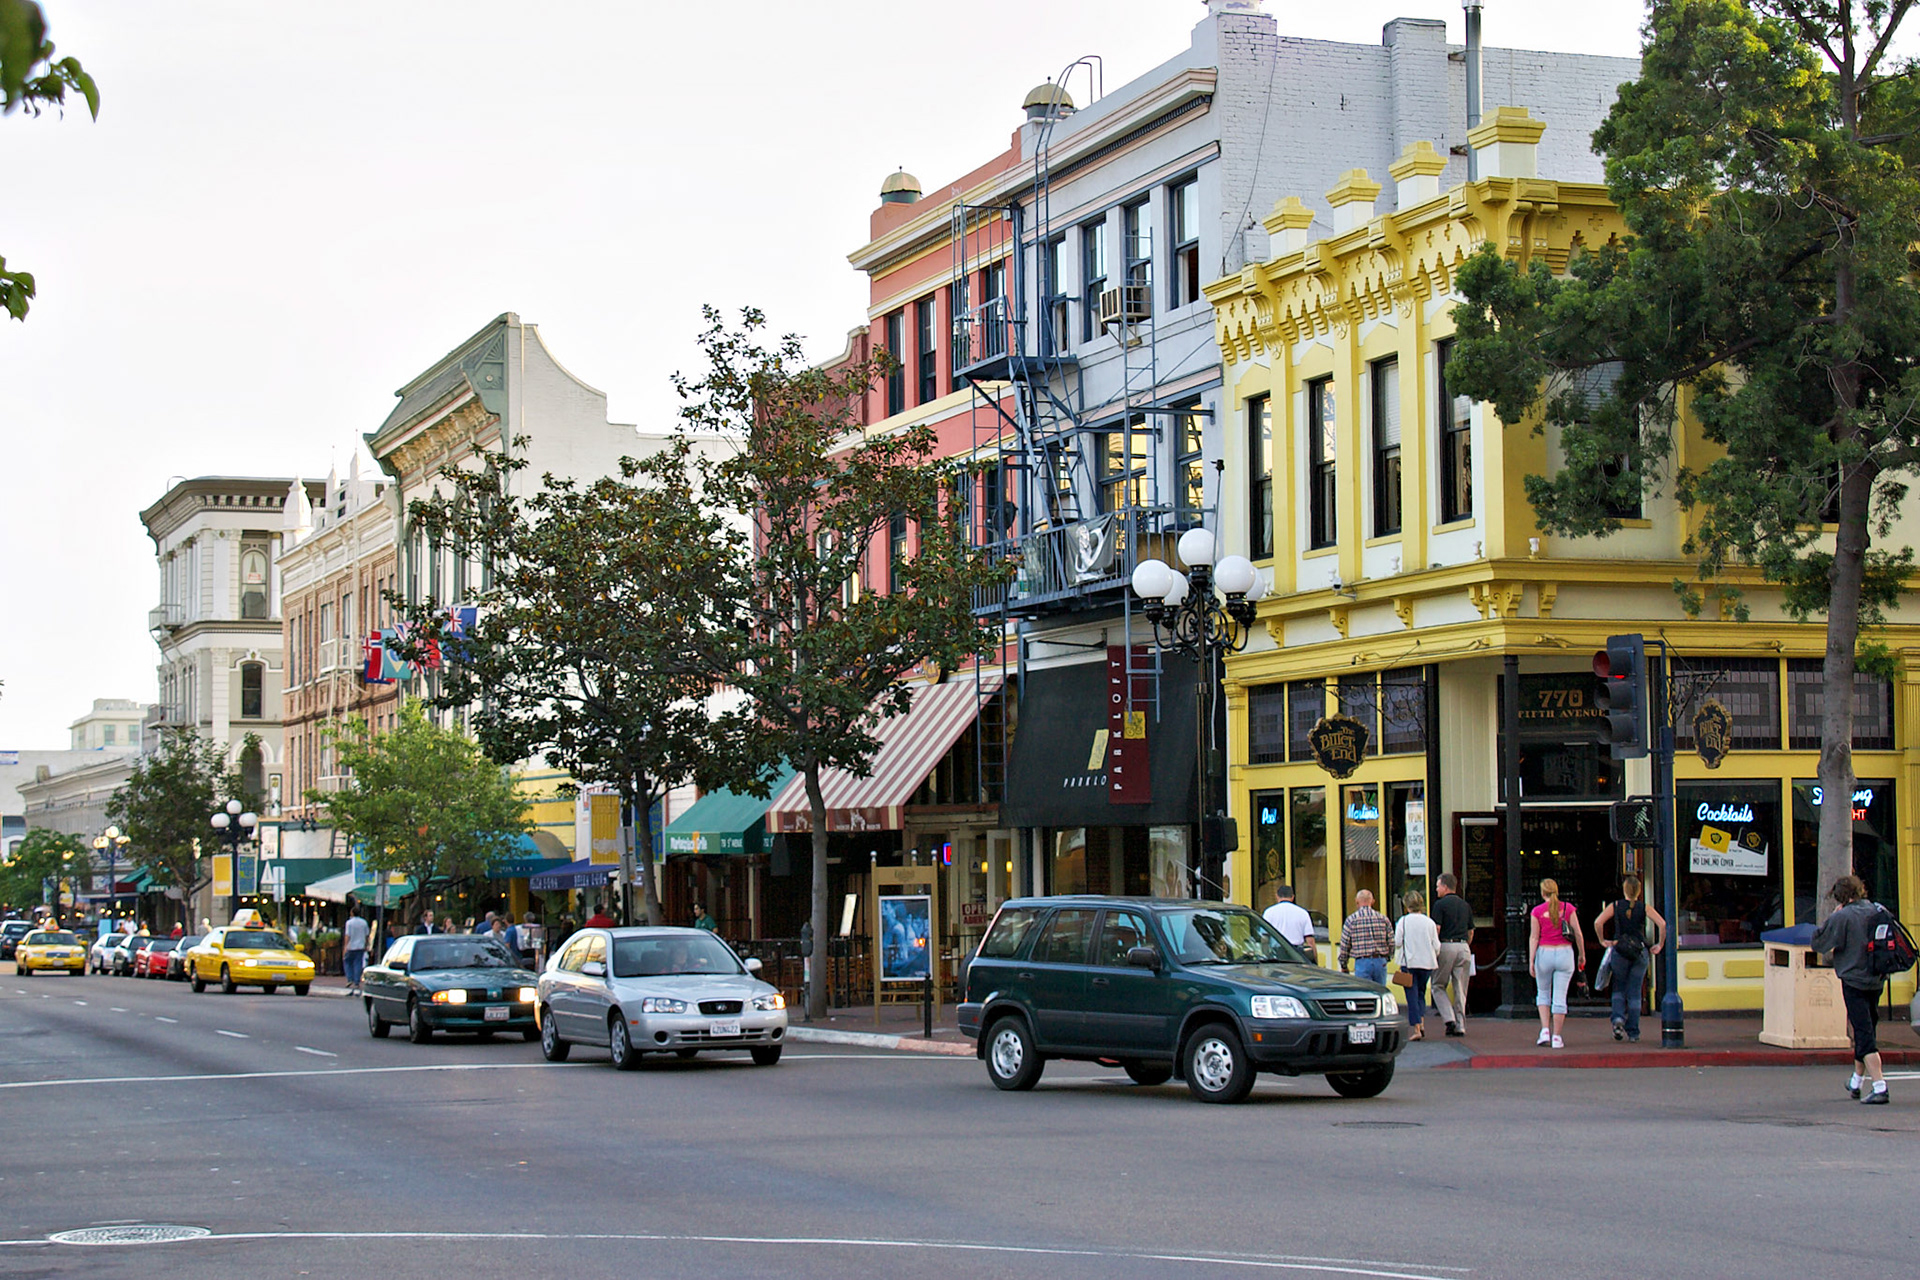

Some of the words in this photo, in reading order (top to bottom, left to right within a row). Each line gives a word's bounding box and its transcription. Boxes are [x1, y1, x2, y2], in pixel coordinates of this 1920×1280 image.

[1539, 689, 1583, 708] 770
[1517, 710, 1554, 718] FIFTH
[1561, 709, 1606, 718] AVENUE
[1331, 746, 1357, 763] End
[1063, 775, 1107, 788] PARKLO
[1261, 807, 1278, 824] Pool
[1347, 803, 1380, 820] Martinis
[1696, 802, 1754, 822] Cocktails
[1693, 857, 1700, 866] NO
[1712, 858, 1719, 867] NO
